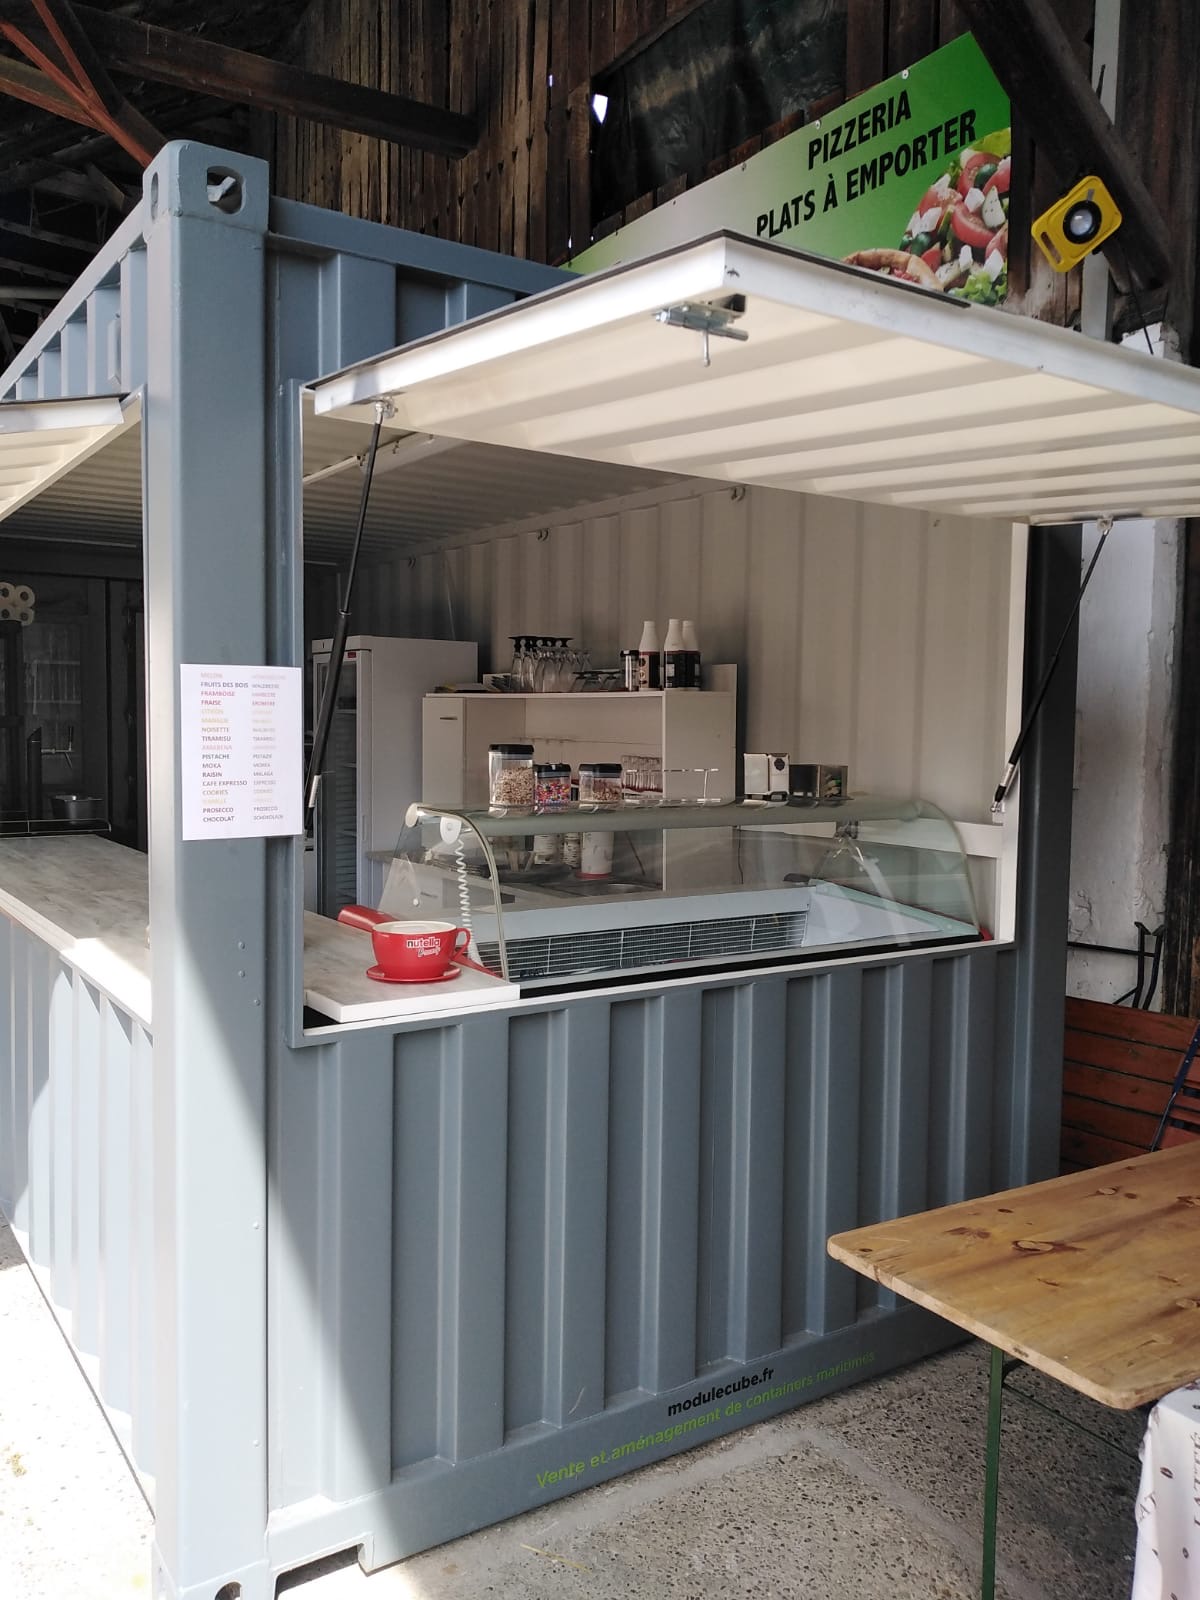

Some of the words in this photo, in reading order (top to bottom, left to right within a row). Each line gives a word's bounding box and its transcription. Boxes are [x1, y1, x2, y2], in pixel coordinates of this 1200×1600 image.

[808, 90, 911, 170] PIZZERIA
[756, 189, 816, 239] PLATS
[822, 173, 838, 212] À
[846, 109, 977, 202] EMPORTER
[202, 815, 236, 823] CHOCOLAT
[407, 937, 440, 948] nutella
[667, 1367, 775, 1417] modulecube.fr
[536, 1460, 586, 1489] Vente
[590, 1450, 608, 1468] et
[611, 1408, 721, 1460] aménagement
[724, 1400, 743, 1417] de
[746, 1374, 813, 1409] containers
